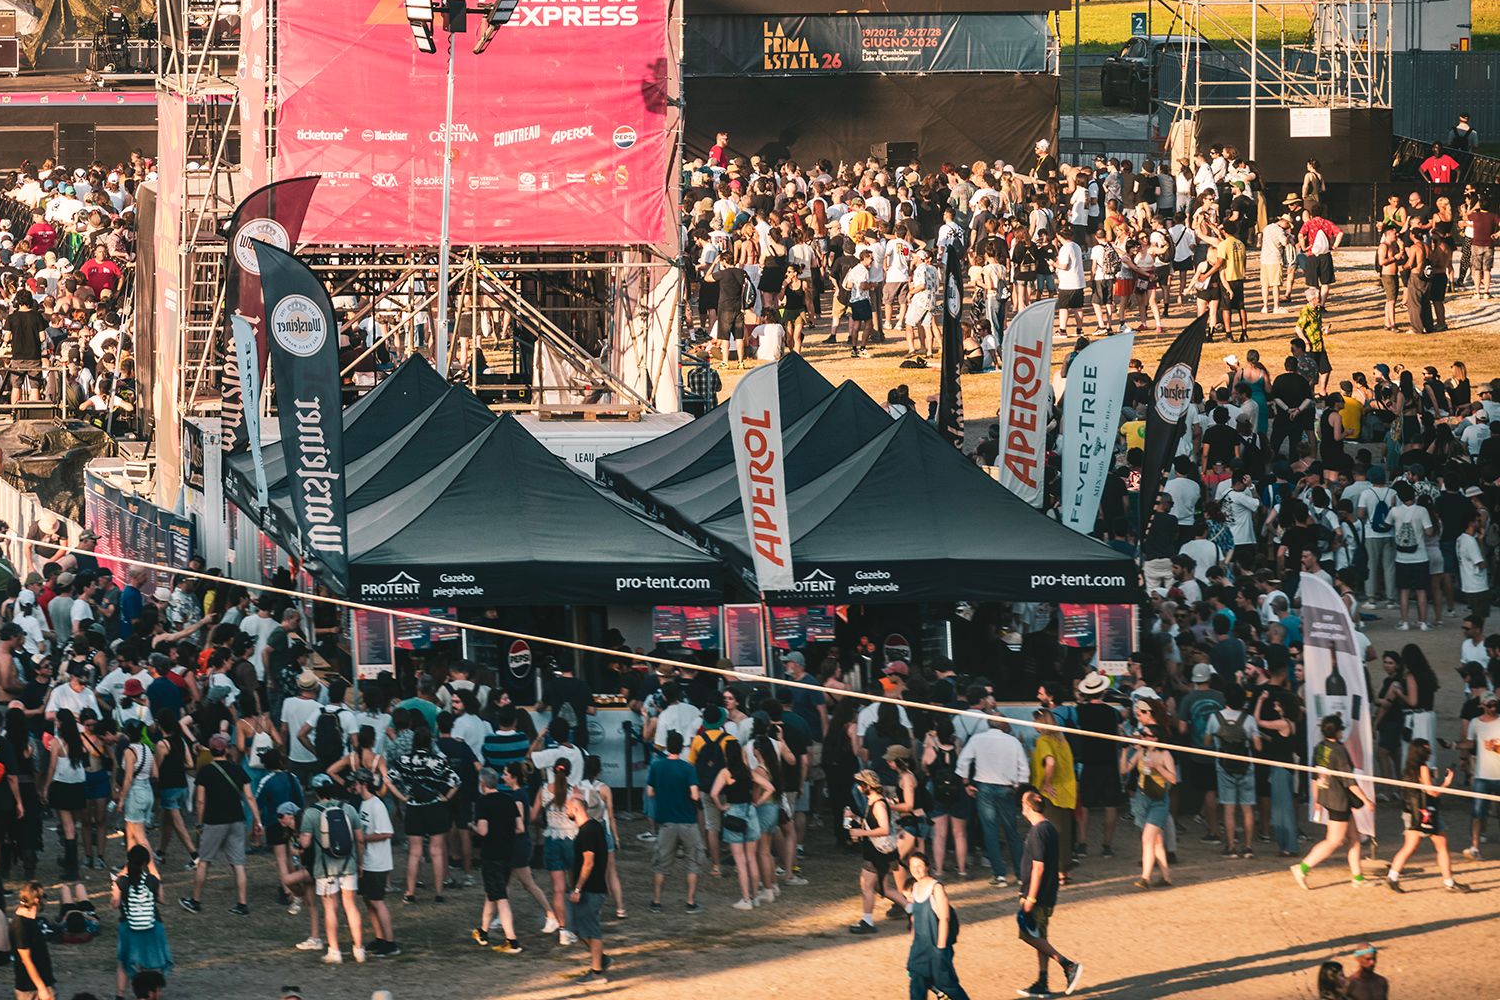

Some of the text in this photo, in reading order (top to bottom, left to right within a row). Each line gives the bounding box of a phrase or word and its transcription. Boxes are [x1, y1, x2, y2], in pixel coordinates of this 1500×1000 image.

[501, 6, 639, 27] EXPRESS
[763, 21, 785, 37] LA
[1135, 17, 1143, 29] 2
[861, 28, 897, 37] 19/20/21
[904, 28, 942, 37] 26/27/28
[763, 37, 810, 53] PRIMA
[862, 37, 938, 48] GIUGNO 2026
[763, 53, 842, 70] ESTATE 26
[439, 123, 469, 132] SNTA
[429, 131, 479, 142] CRTINA
[493, 124, 541, 147] COINTREAU
[550, 125, 595, 145] APEROL
[1004, 340, 1043, 489] APEROL
[1070, 365, 1097, 523] FEVER-TREE
[574, 452, 595, 463] LEAU
[741, 409, 784, 567] APEROL
[439, 573, 475, 583] Gazebo
[855, 570, 891, 580] Gazebo
[1031, 573, 1126, 588] pro-tent.com
[361, 583, 421, 595] PROTENT
[615, 576, 711, 591] pro-tent.com
[778, 580, 837, 592] OTENT
[848, 582, 900, 594] pieghevole
[432, 586, 484, 598] pieghevole
